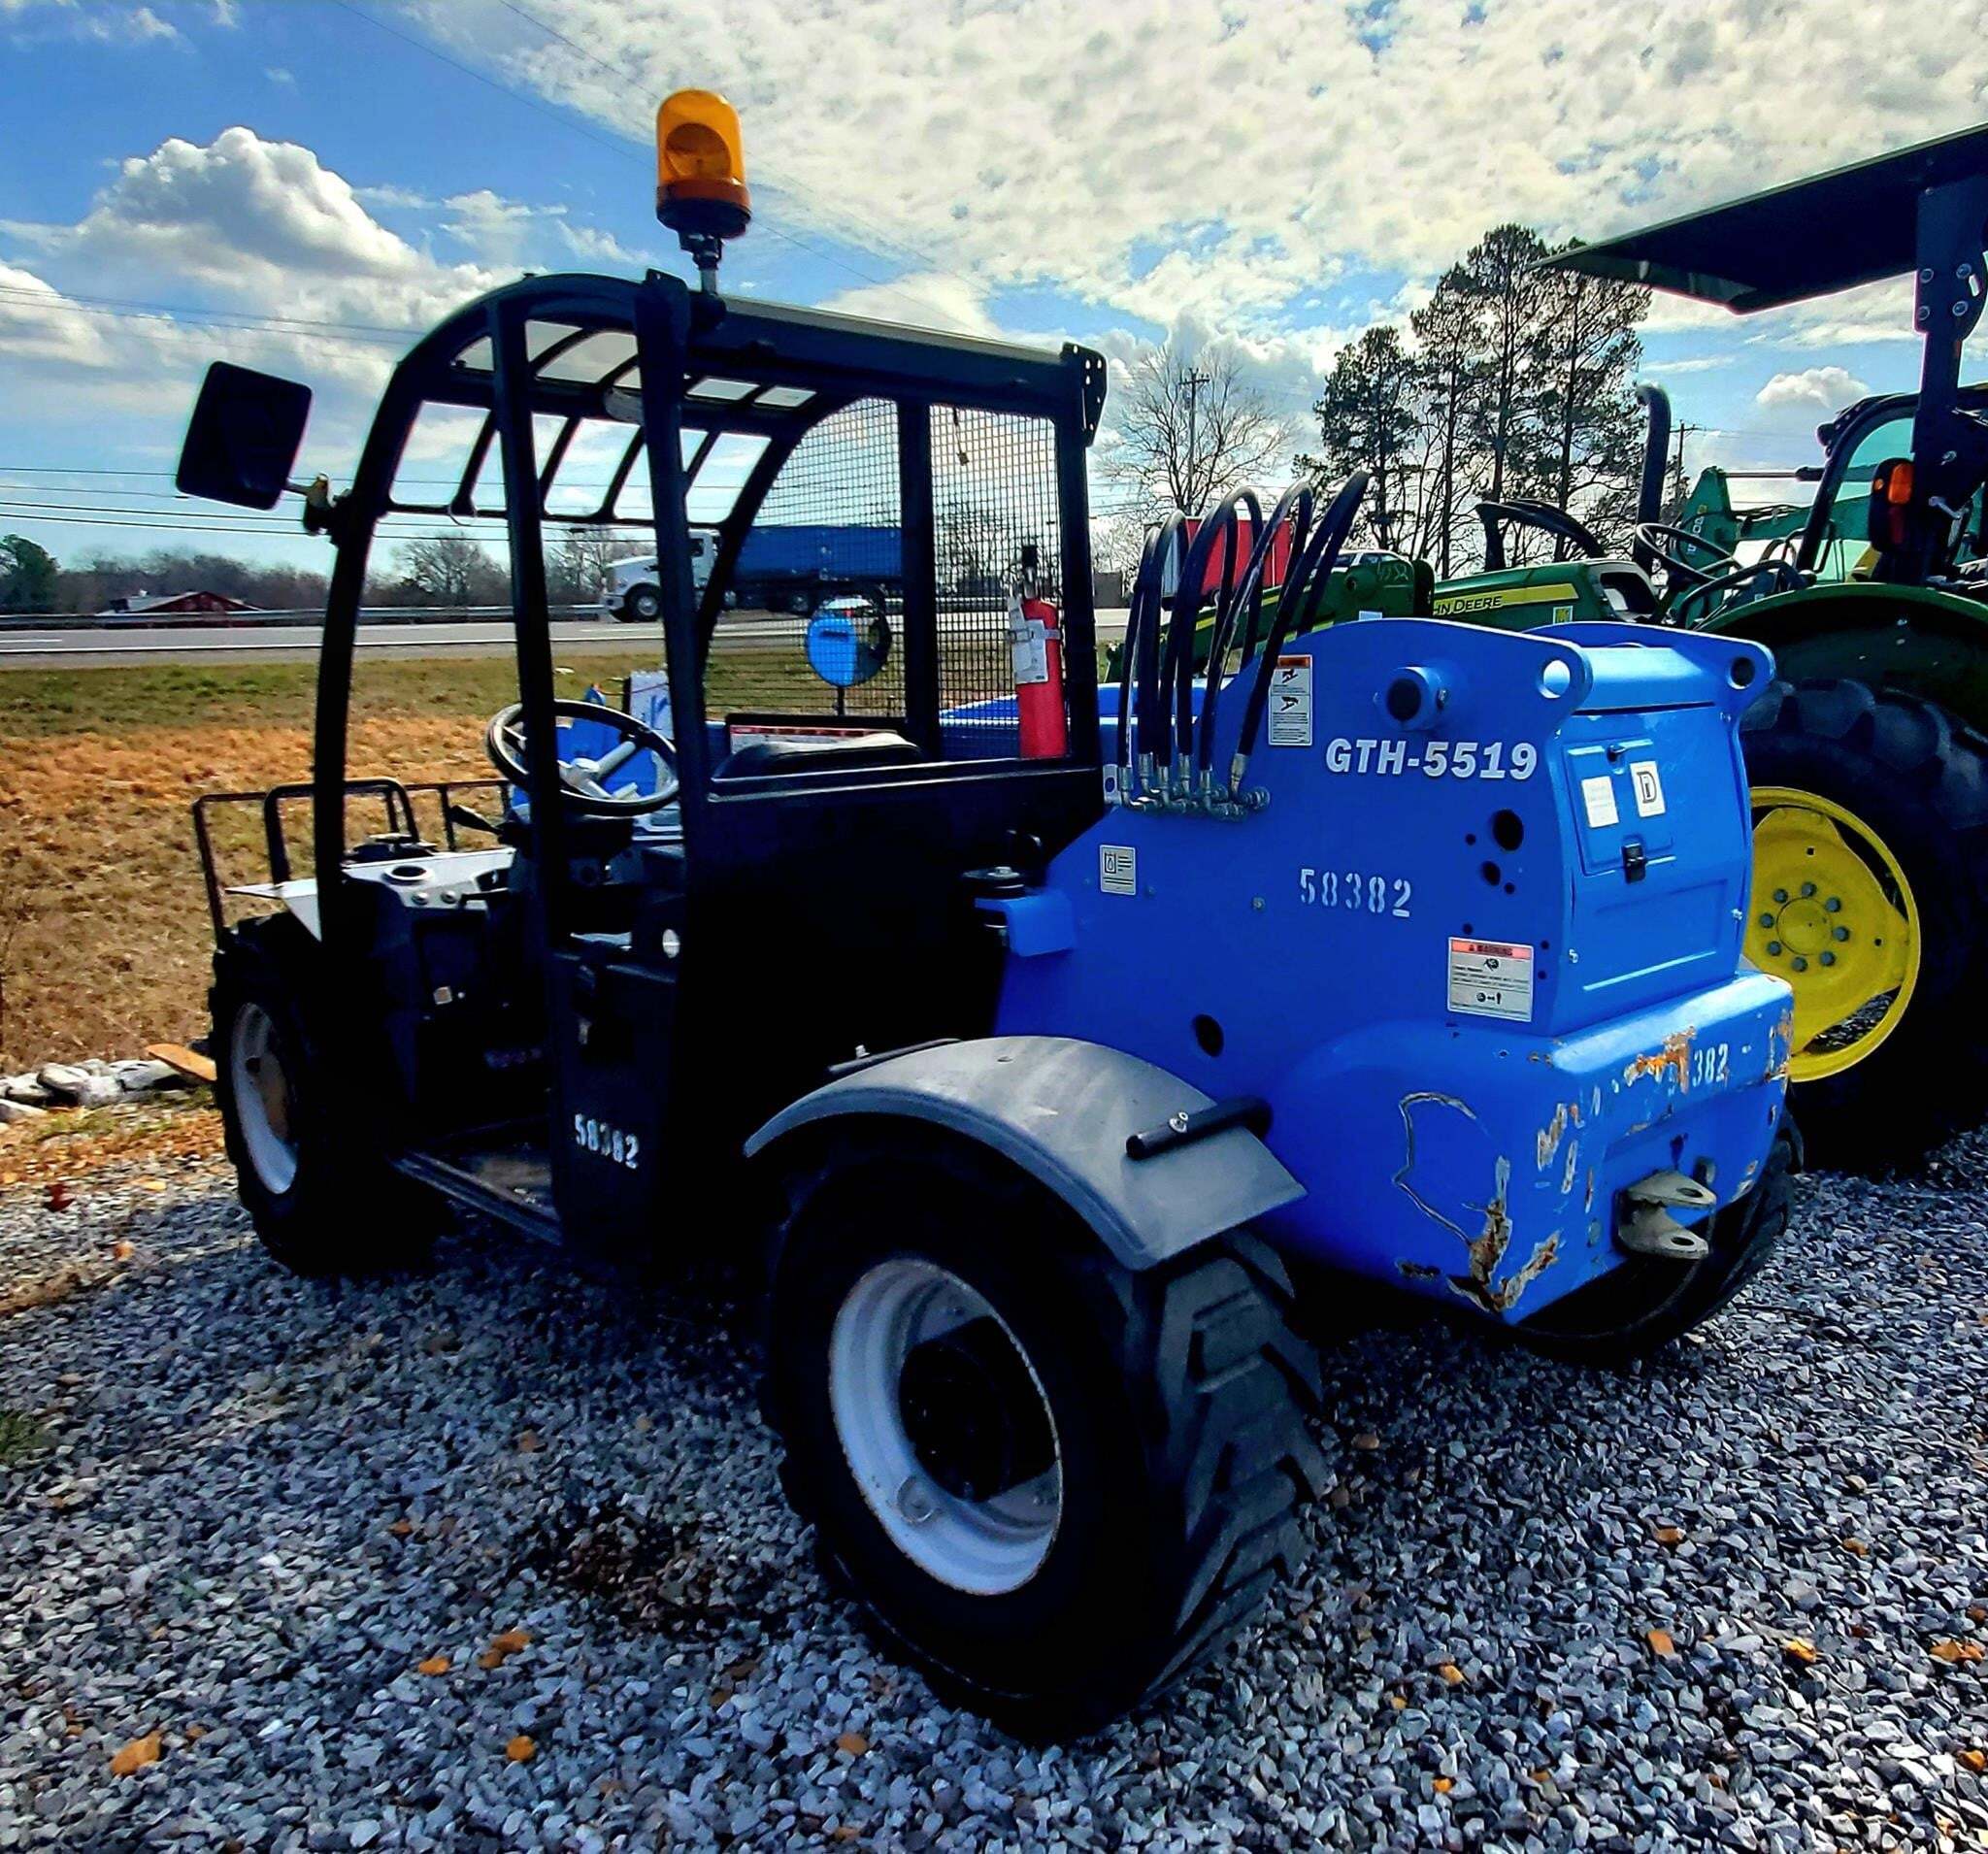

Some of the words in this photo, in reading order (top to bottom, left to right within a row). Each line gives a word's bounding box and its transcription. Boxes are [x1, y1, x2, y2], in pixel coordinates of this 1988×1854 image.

[1453, 595, 1503, 613] DEERE
[1325, 738, 1538, 780] GTH-5519
[1300, 868, 1411, 918] 58382
[1682, 1043, 1729, 1088] 382
[575, 1113, 640, 1170] 58382
